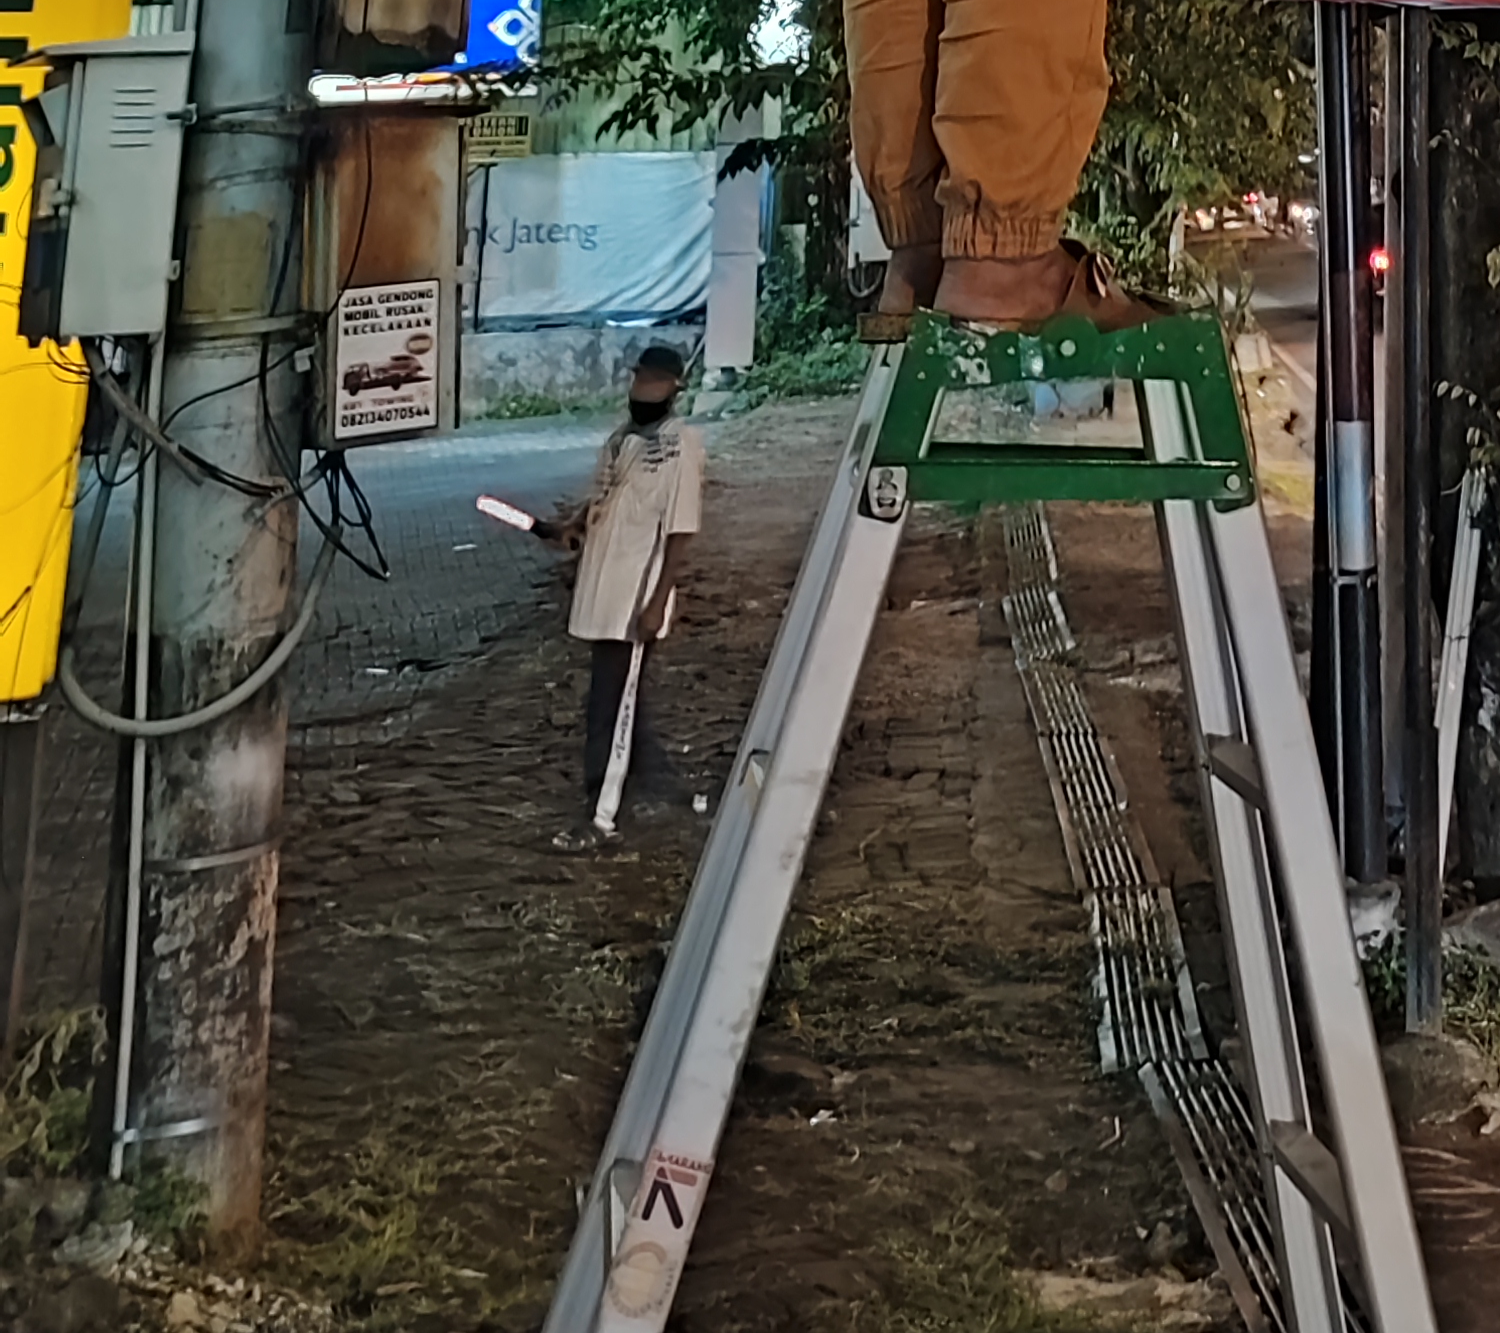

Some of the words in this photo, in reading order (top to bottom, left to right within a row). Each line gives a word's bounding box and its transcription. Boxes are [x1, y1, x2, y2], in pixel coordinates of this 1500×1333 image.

[503, 217, 599, 253] Jateng
[343, 295, 373, 308] JASA
[378, 289, 434, 304] GENDONG
[344, 309, 382, 322] MOBIL
